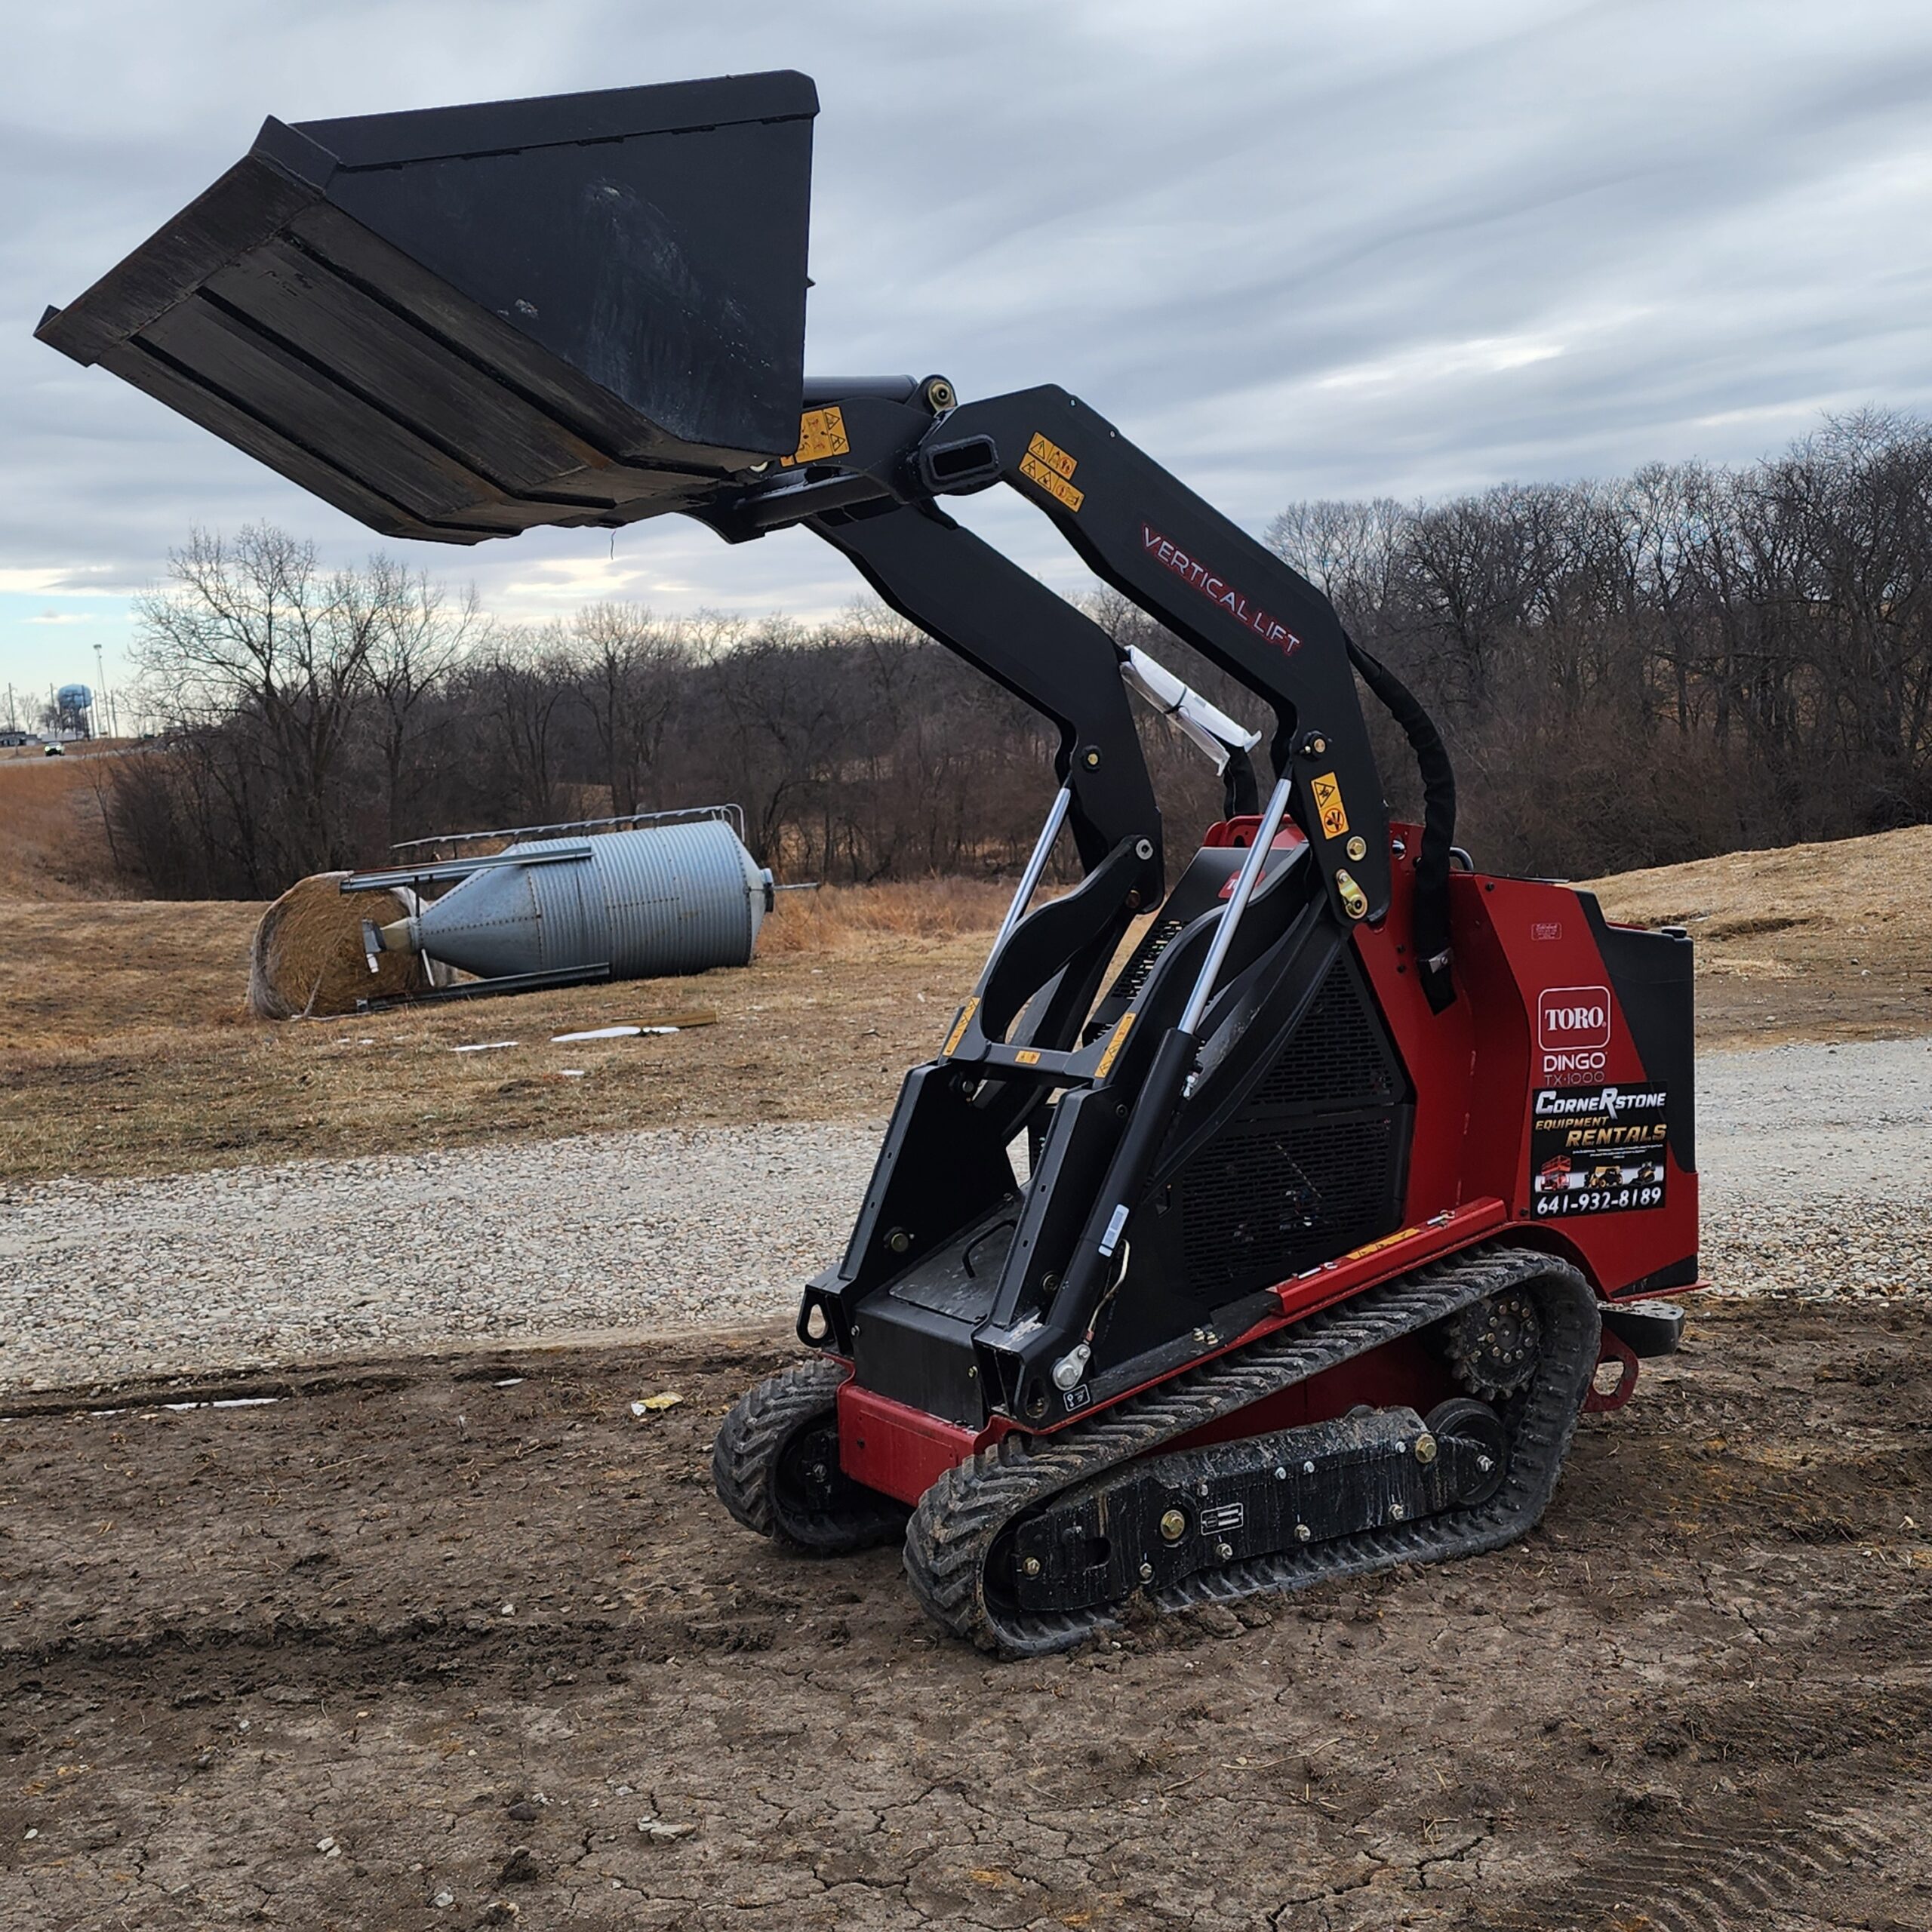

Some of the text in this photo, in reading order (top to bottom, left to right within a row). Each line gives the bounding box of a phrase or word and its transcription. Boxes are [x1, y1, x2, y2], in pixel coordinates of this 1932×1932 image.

[1143, 526, 1300, 653] VERTICAL LIFT
[1544, 1006, 1604, 1031] TORO
[1543, 1051, 1606, 1072] DINGO
[1535, 1115, 1610, 1131] EQUIPMENT
[1565, 1124, 1668, 1147] RENTALS
[1537, 1186, 1662, 1215] 641-932-8189
